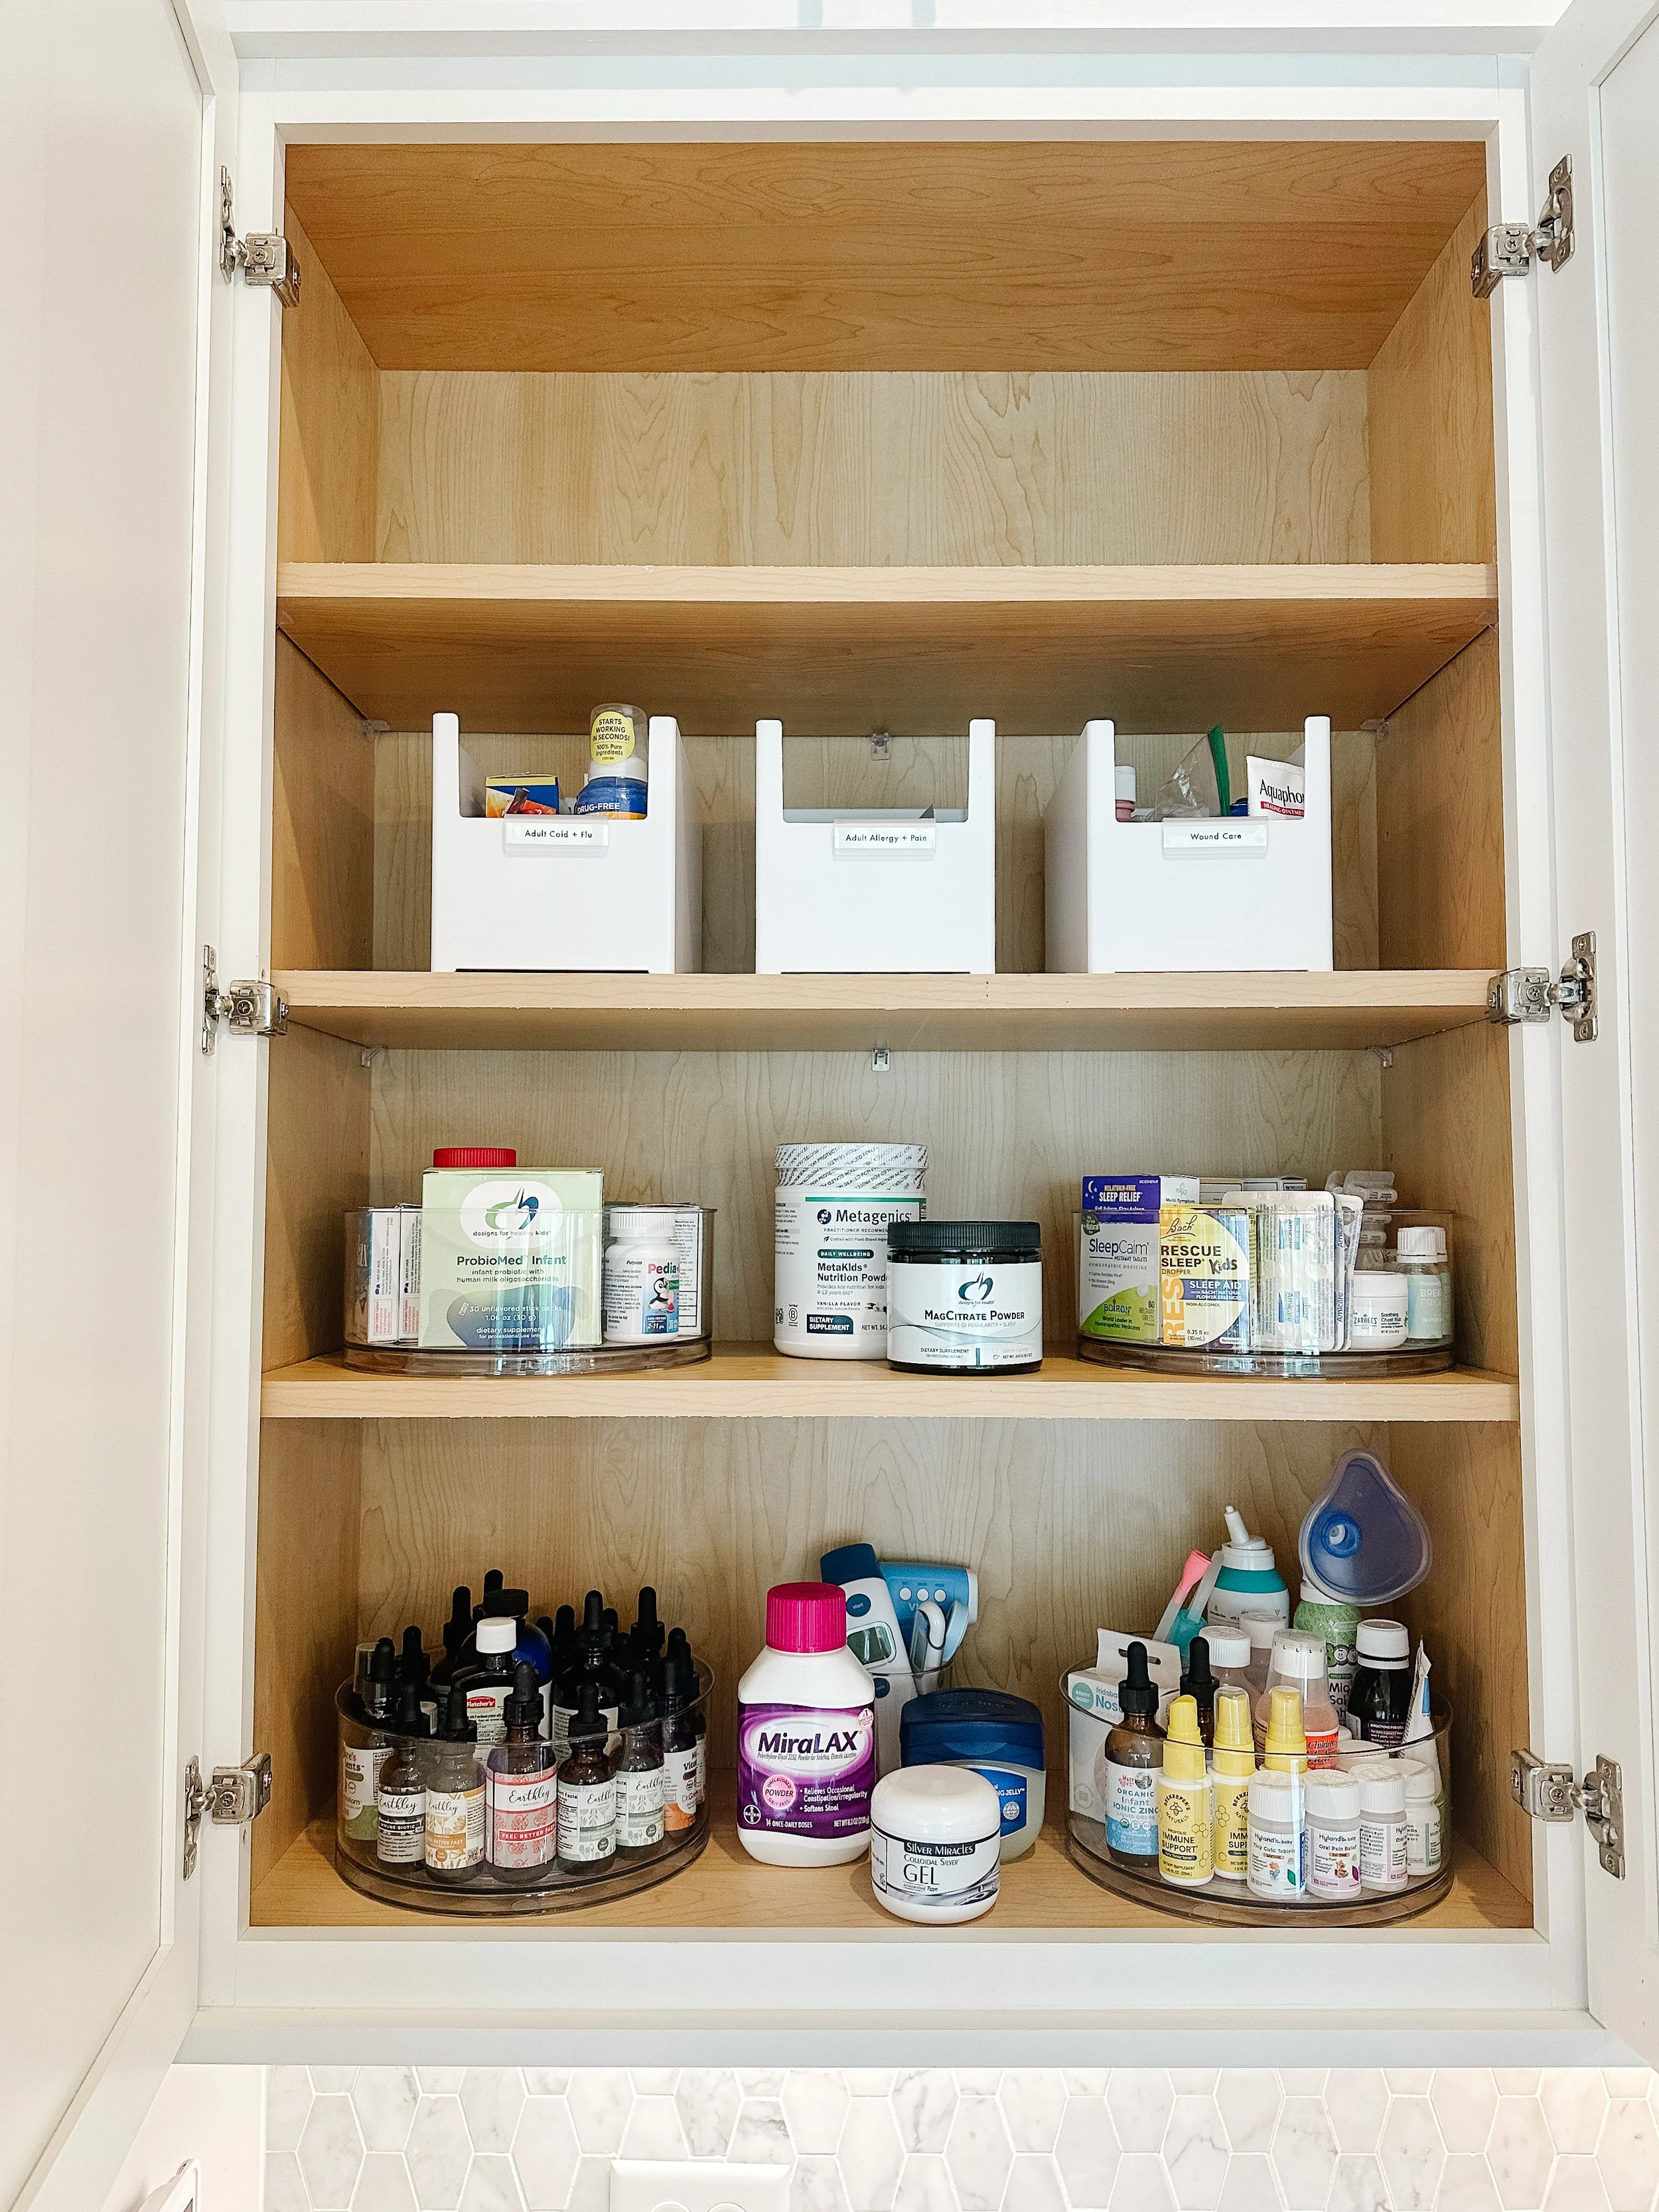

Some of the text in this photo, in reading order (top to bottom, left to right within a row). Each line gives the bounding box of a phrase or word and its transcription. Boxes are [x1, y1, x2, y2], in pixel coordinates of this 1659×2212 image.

[598, 733, 630, 742] SECONDS!
[577, 802, 620, 814] DRUG-FREE
[525, 830, 547, 838] Adult
[869, 834, 899, 844] Allergy
[1099, 1192, 1141, 1203] SLEEP RELIEF
[835, 1209, 910, 1225] Metagenics
[1167, 1215, 1198, 1234] Bach
[1089, 1238, 1147, 1256] SleepCalm
[1161, 1246, 1221, 1256] RESCUE
[457, 1255, 567, 1266] ProbioMed Infant
[1161, 1258, 1238, 1274] SLEEP Kids
[818, 1273, 858, 1282] Nutrition
[1189, 1280, 1242, 1290] SLEEP AID
[1104, 1301, 1130, 1314] BOIRON
[1094, 1320, 1121, 1329] Homeopathic
[758, 1730, 859, 1754] MiraLAX
[766, 1777, 792, 1789] UNFLAVORED
[509, 1785, 549, 1804] Earthley
[765, 1789, 793, 1798] POWDER
[804, 1784, 855, 1796] Relieves Occasional
[1117, 1788, 1155, 1797] ORGANIC
[768, 1797, 790, 1807] GRIT FREE
[803, 1791, 868, 1803] Constipation/Irregularity
[1122, 1796, 1150, 1806] Infant
[1114, 1801, 1135, 1813] IONIC
[1166, 1811, 1189, 1824] NATURALS
[519, 1830, 543, 1839] BETTER
[1163, 1831, 1194, 1844] IMMUNE
[1255, 1832, 1279, 1844] Hyland's
[1162, 1840, 1195, 1853] SUPPORT
[903, 1864, 940, 1885] GEL
